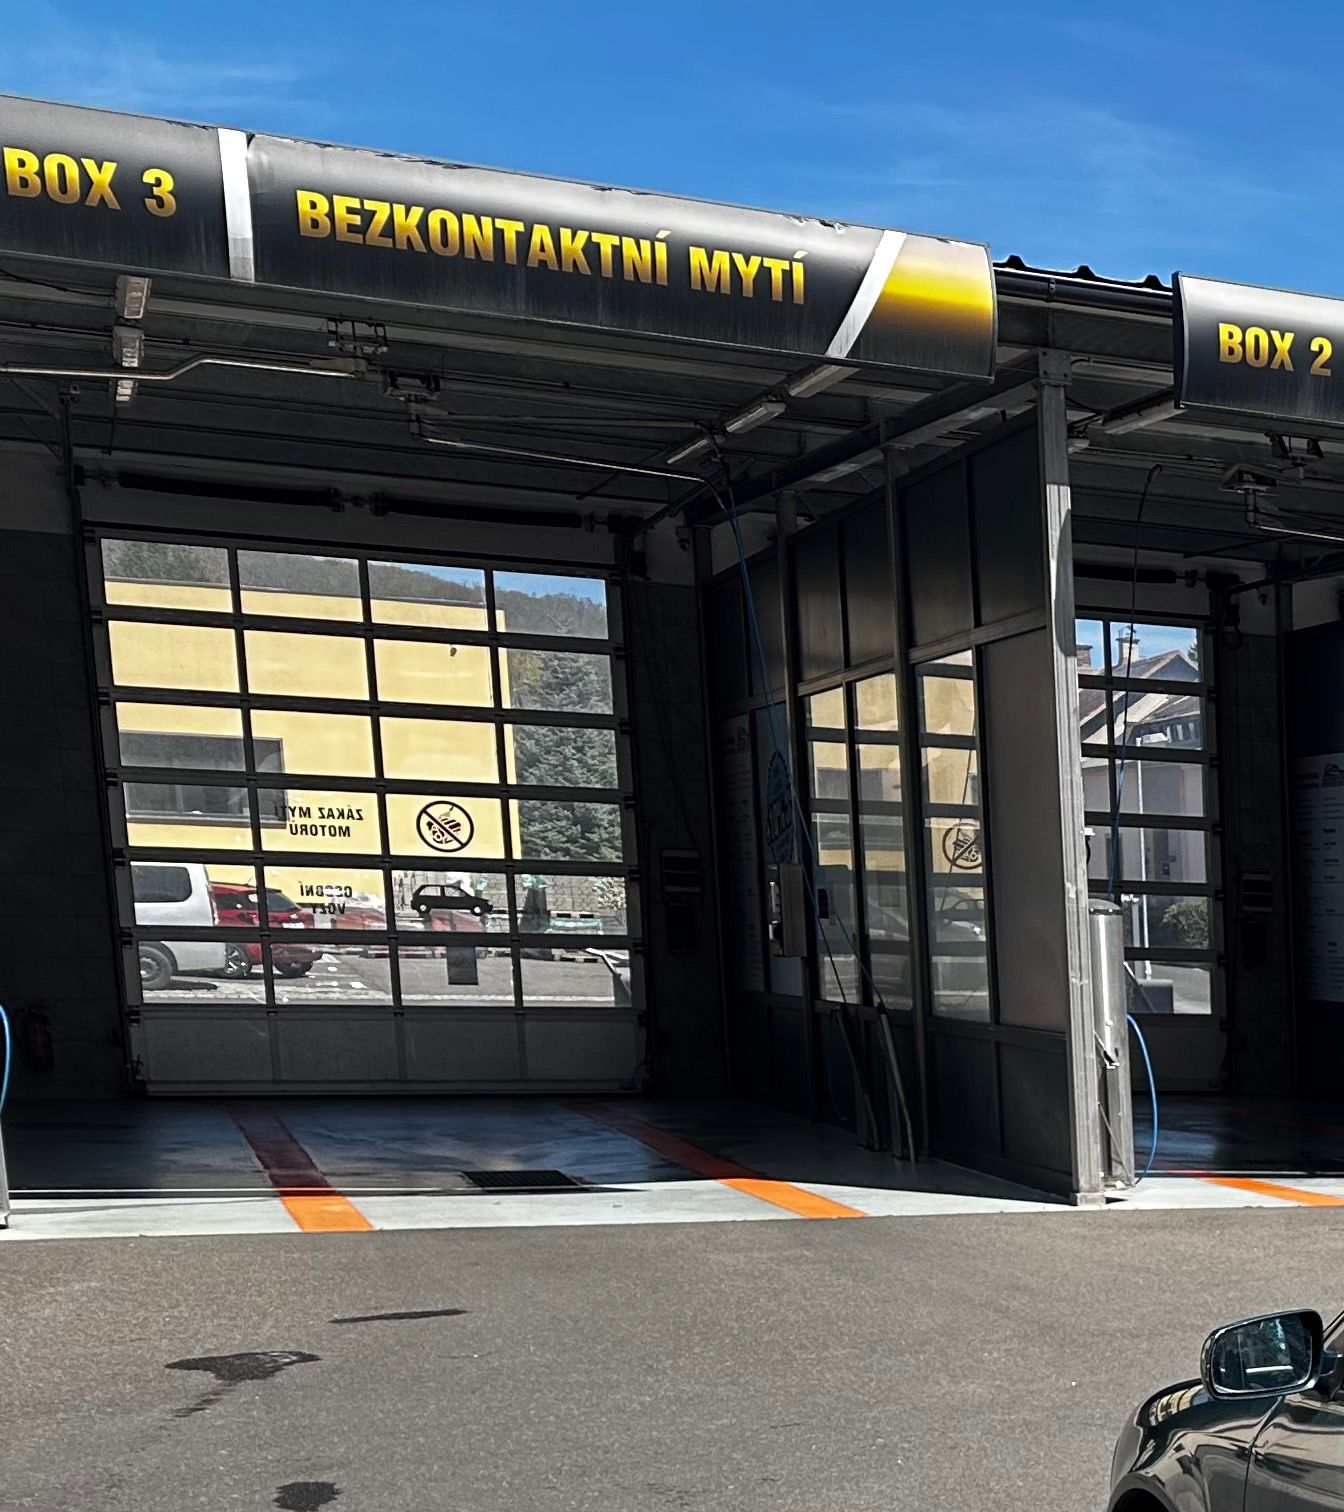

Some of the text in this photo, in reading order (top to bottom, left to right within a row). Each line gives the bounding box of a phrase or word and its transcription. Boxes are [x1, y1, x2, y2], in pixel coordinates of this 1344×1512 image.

[3, 146, 177, 217] BOX 3
[297, 189, 806, 304] BEZKONTAKTNÍ MYTÍ
[1218, 322, 1333, 377] BOX 2
